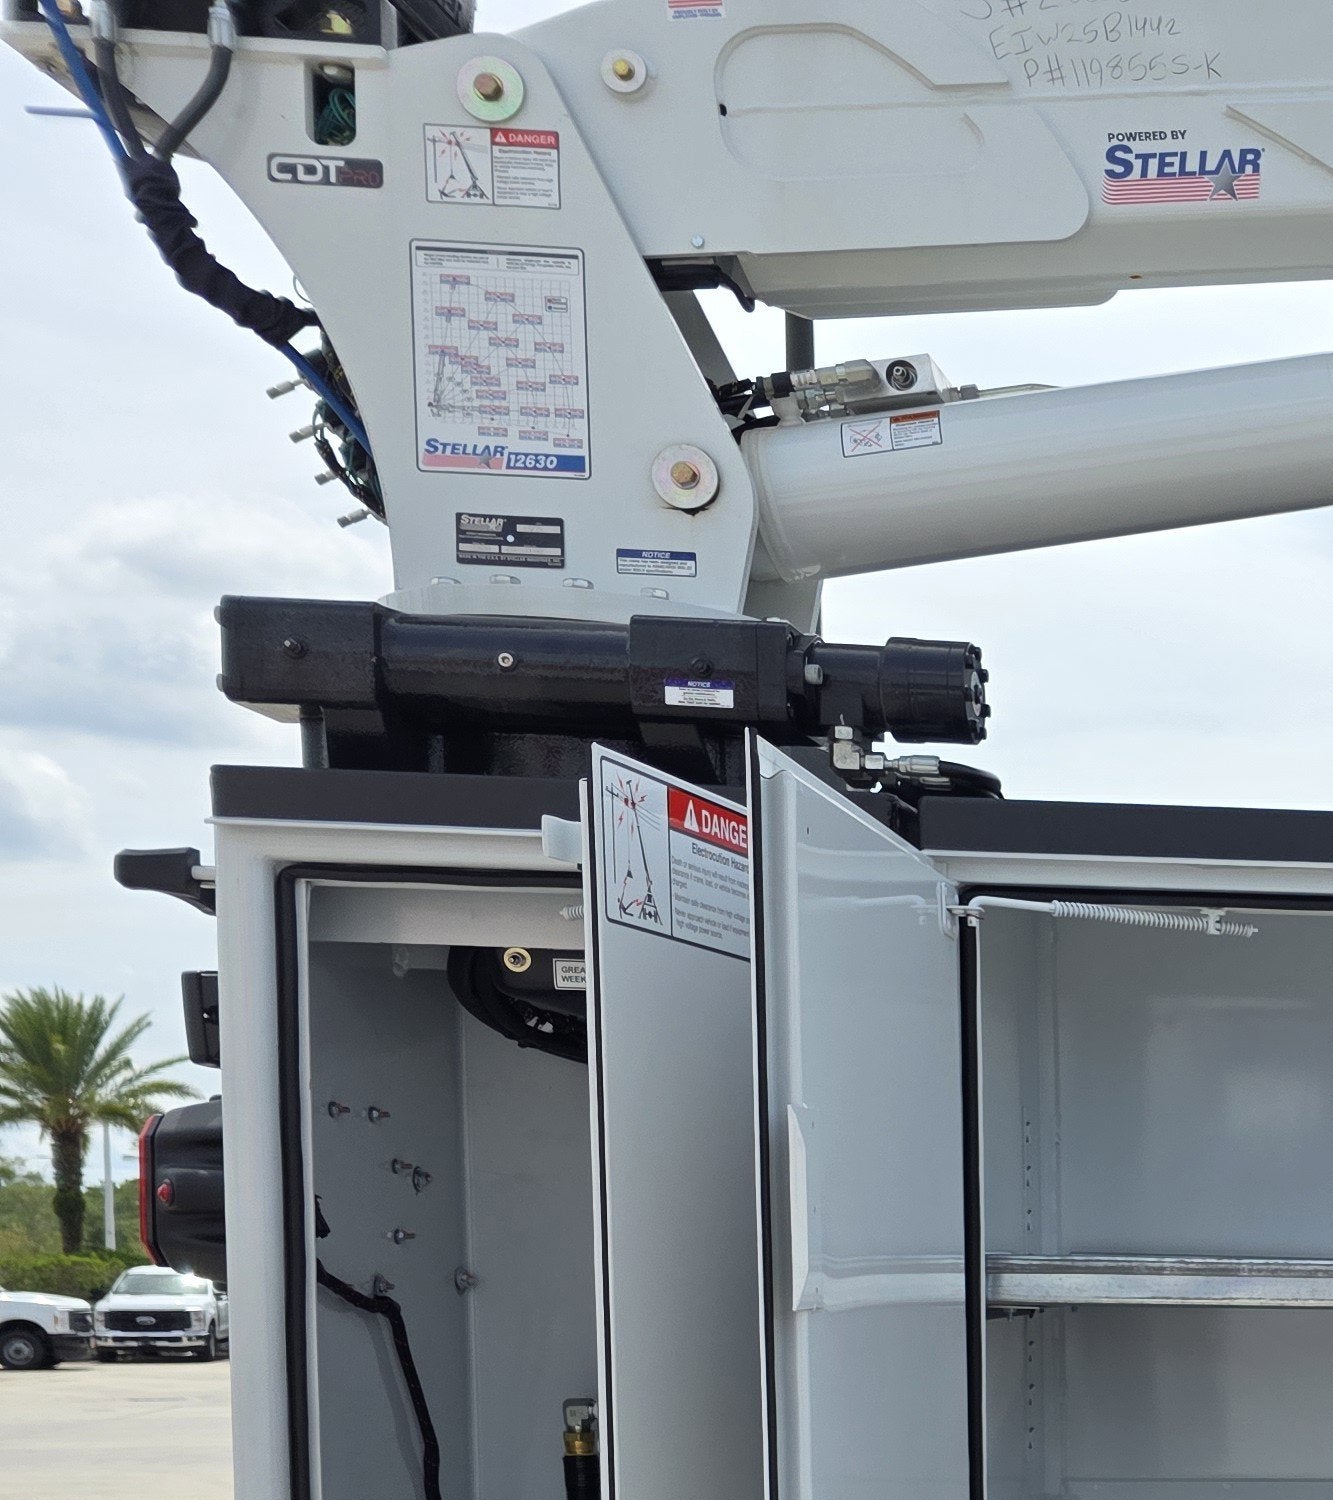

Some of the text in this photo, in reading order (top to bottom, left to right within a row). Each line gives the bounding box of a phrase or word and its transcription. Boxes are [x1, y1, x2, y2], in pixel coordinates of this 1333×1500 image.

[508, 133, 556, 145] DANGER
[1107, 129, 1187, 143] POWERED BY
[1104, 143, 1263, 180] STELLAR
[424, 438, 557, 469] STELLAR 12630
[460, 514, 504, 526] STELLAR
[641, 551, 671, 559] NOTICE
[701, 809, 748, 849] DANGE
[561, 966, 586, 974] GREA
